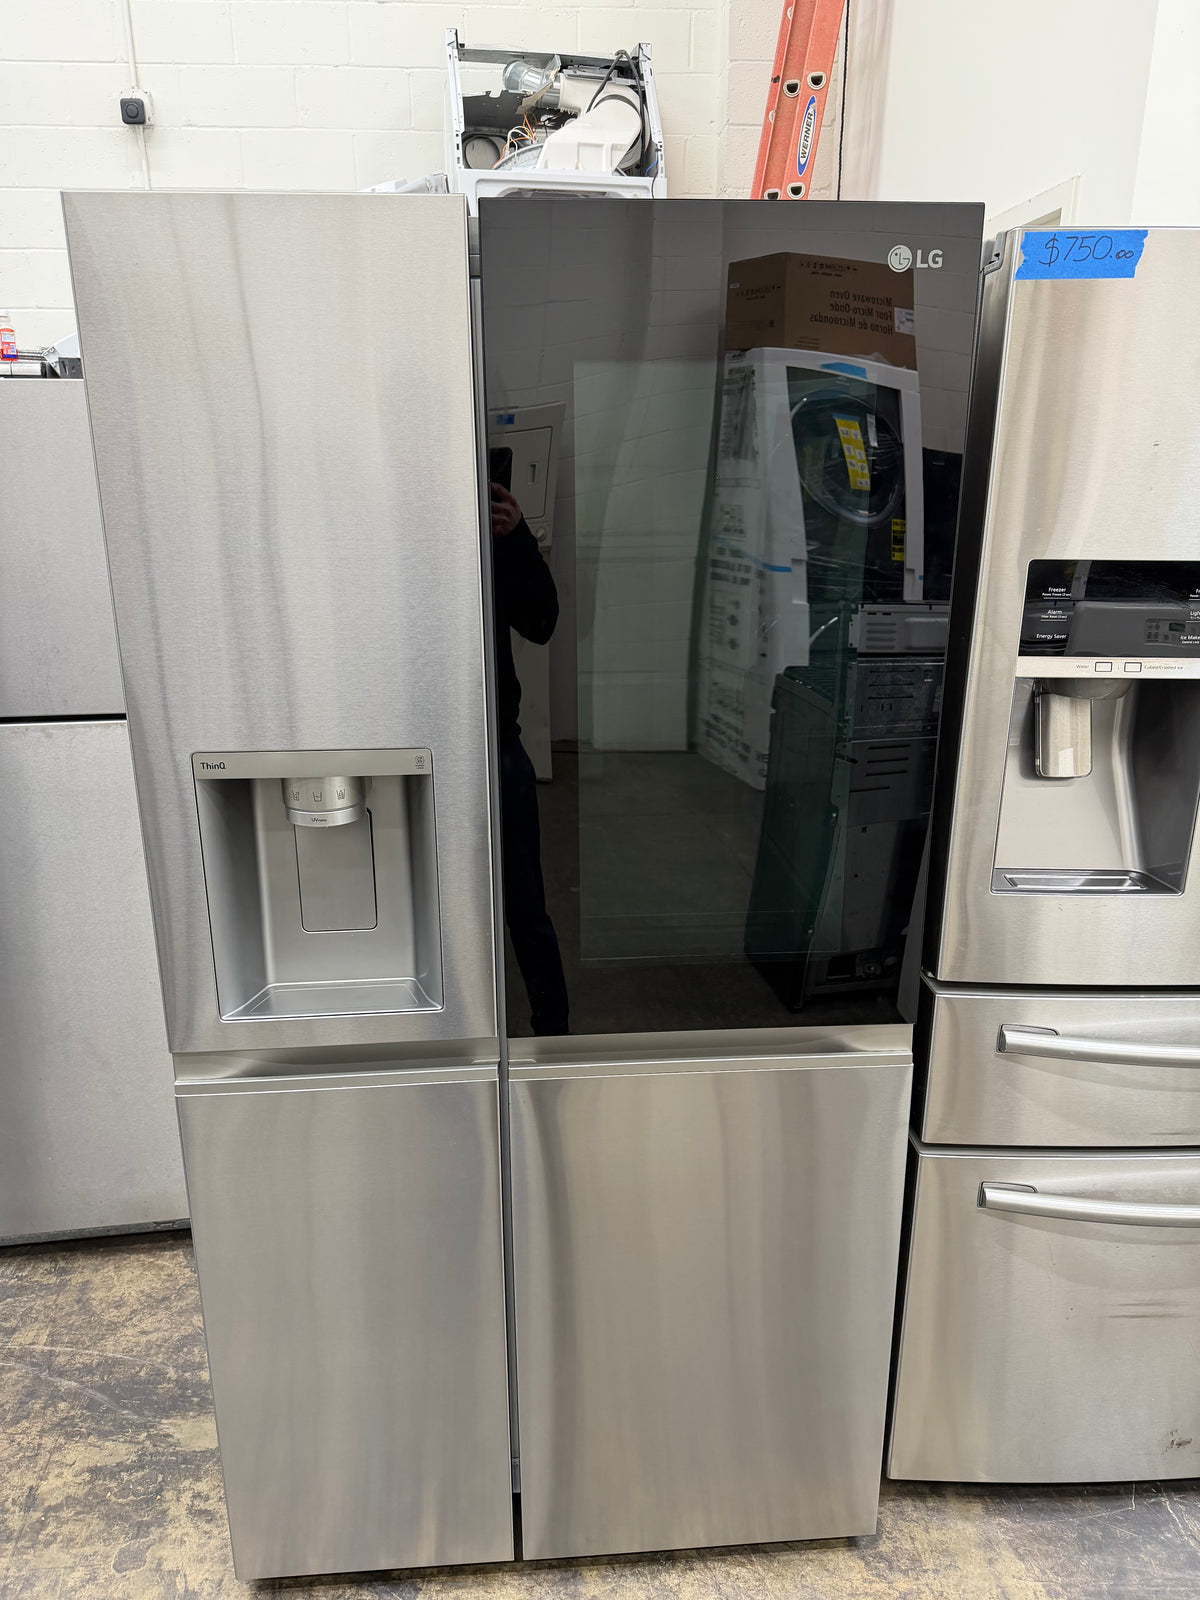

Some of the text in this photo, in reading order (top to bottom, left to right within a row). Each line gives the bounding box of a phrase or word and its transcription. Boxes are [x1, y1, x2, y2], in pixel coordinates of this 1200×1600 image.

[800, 111, 814, 160] WERNER
[916, 249, 944, 269] LG
[1038, 233, 1135, 268] $750.00
[200, 761, 227, 771] ThinQ
